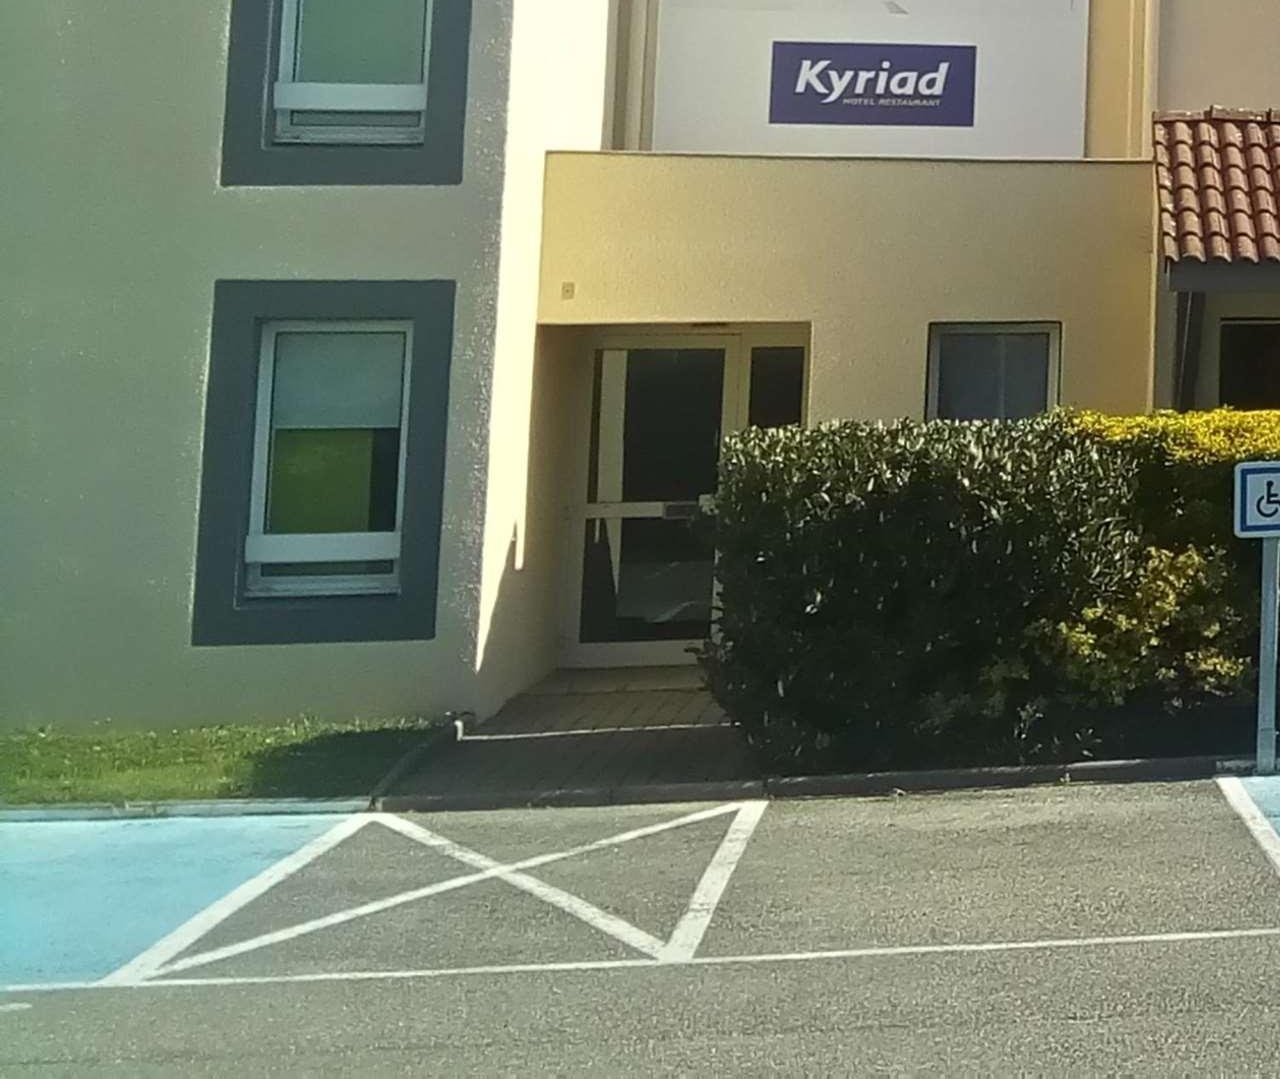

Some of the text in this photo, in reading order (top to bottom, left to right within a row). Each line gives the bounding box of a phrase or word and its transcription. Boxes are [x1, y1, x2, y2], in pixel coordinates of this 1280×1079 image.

[795, 59, 950, 104] Kyriad
[842, 98, 941, 107] HOTEL RESTAURANT
